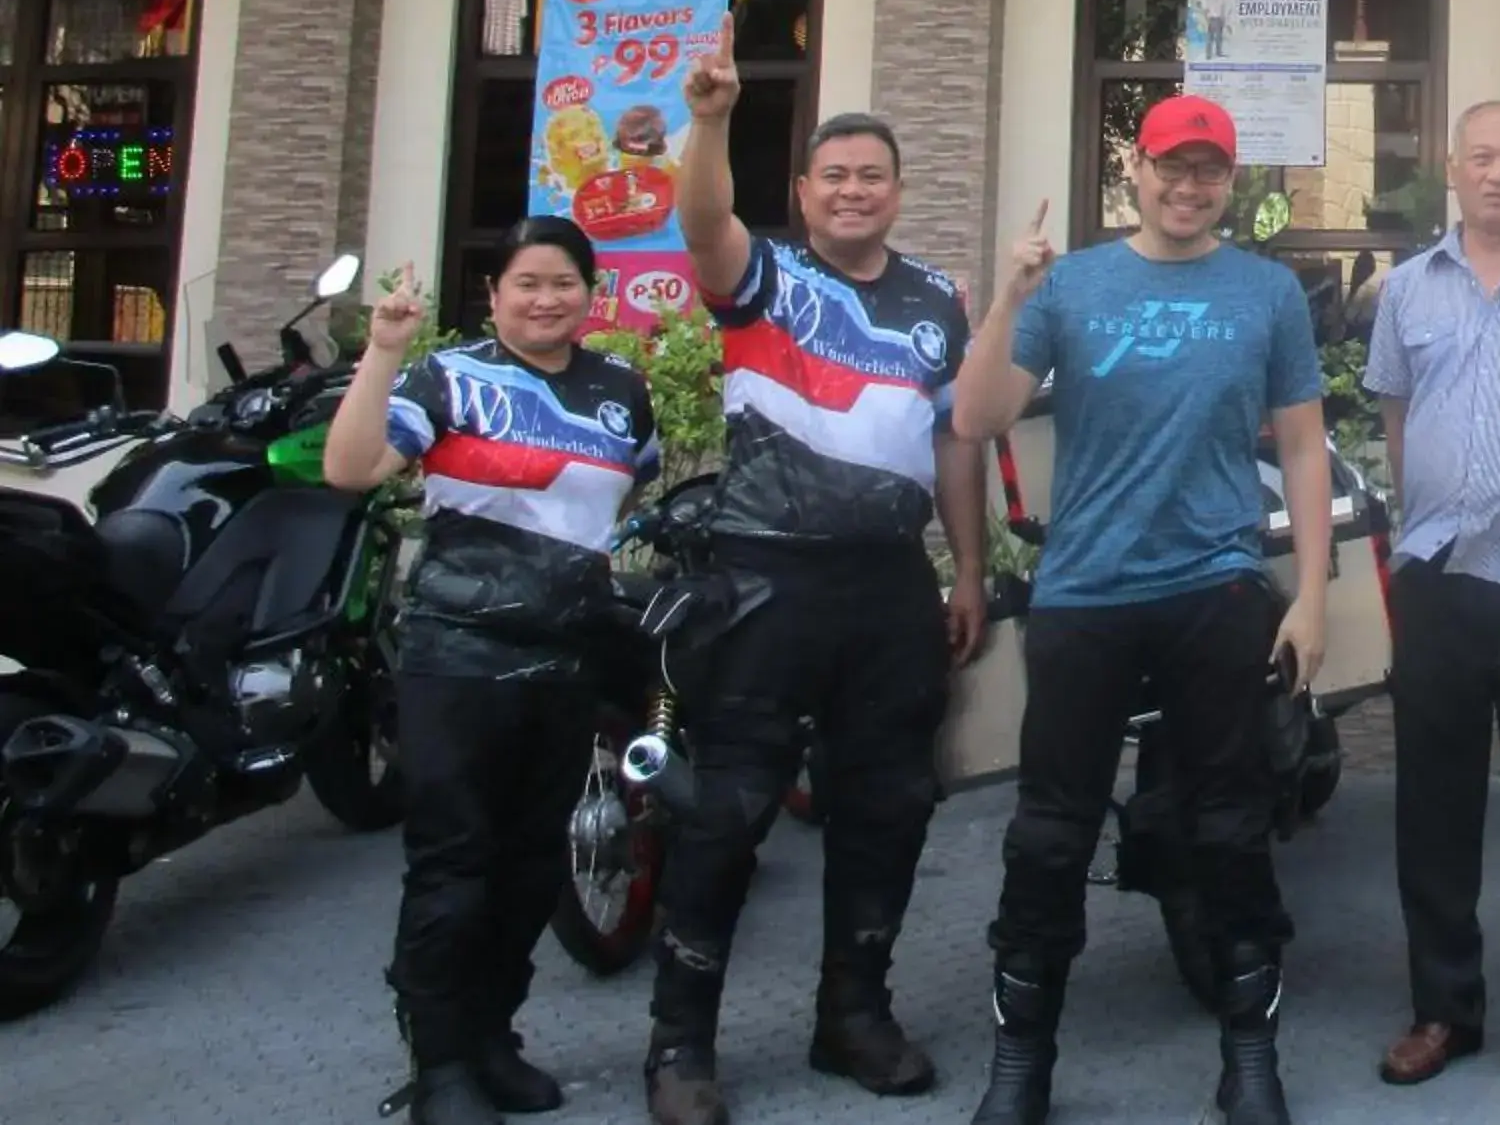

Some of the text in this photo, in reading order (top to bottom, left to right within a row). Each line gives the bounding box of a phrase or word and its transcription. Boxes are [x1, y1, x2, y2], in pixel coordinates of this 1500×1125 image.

[1239, 2, 1320, 16] EMPLOYMENT
[575, 6, 694, 47] 3 Flavors
[59, 146, 173, 180] OPEN
[1088, 320, 1236, 341] PERSEVERE
[812, 338, 907, 378] Wunderlich
[510, 428, 604, 458] Wunderlich
